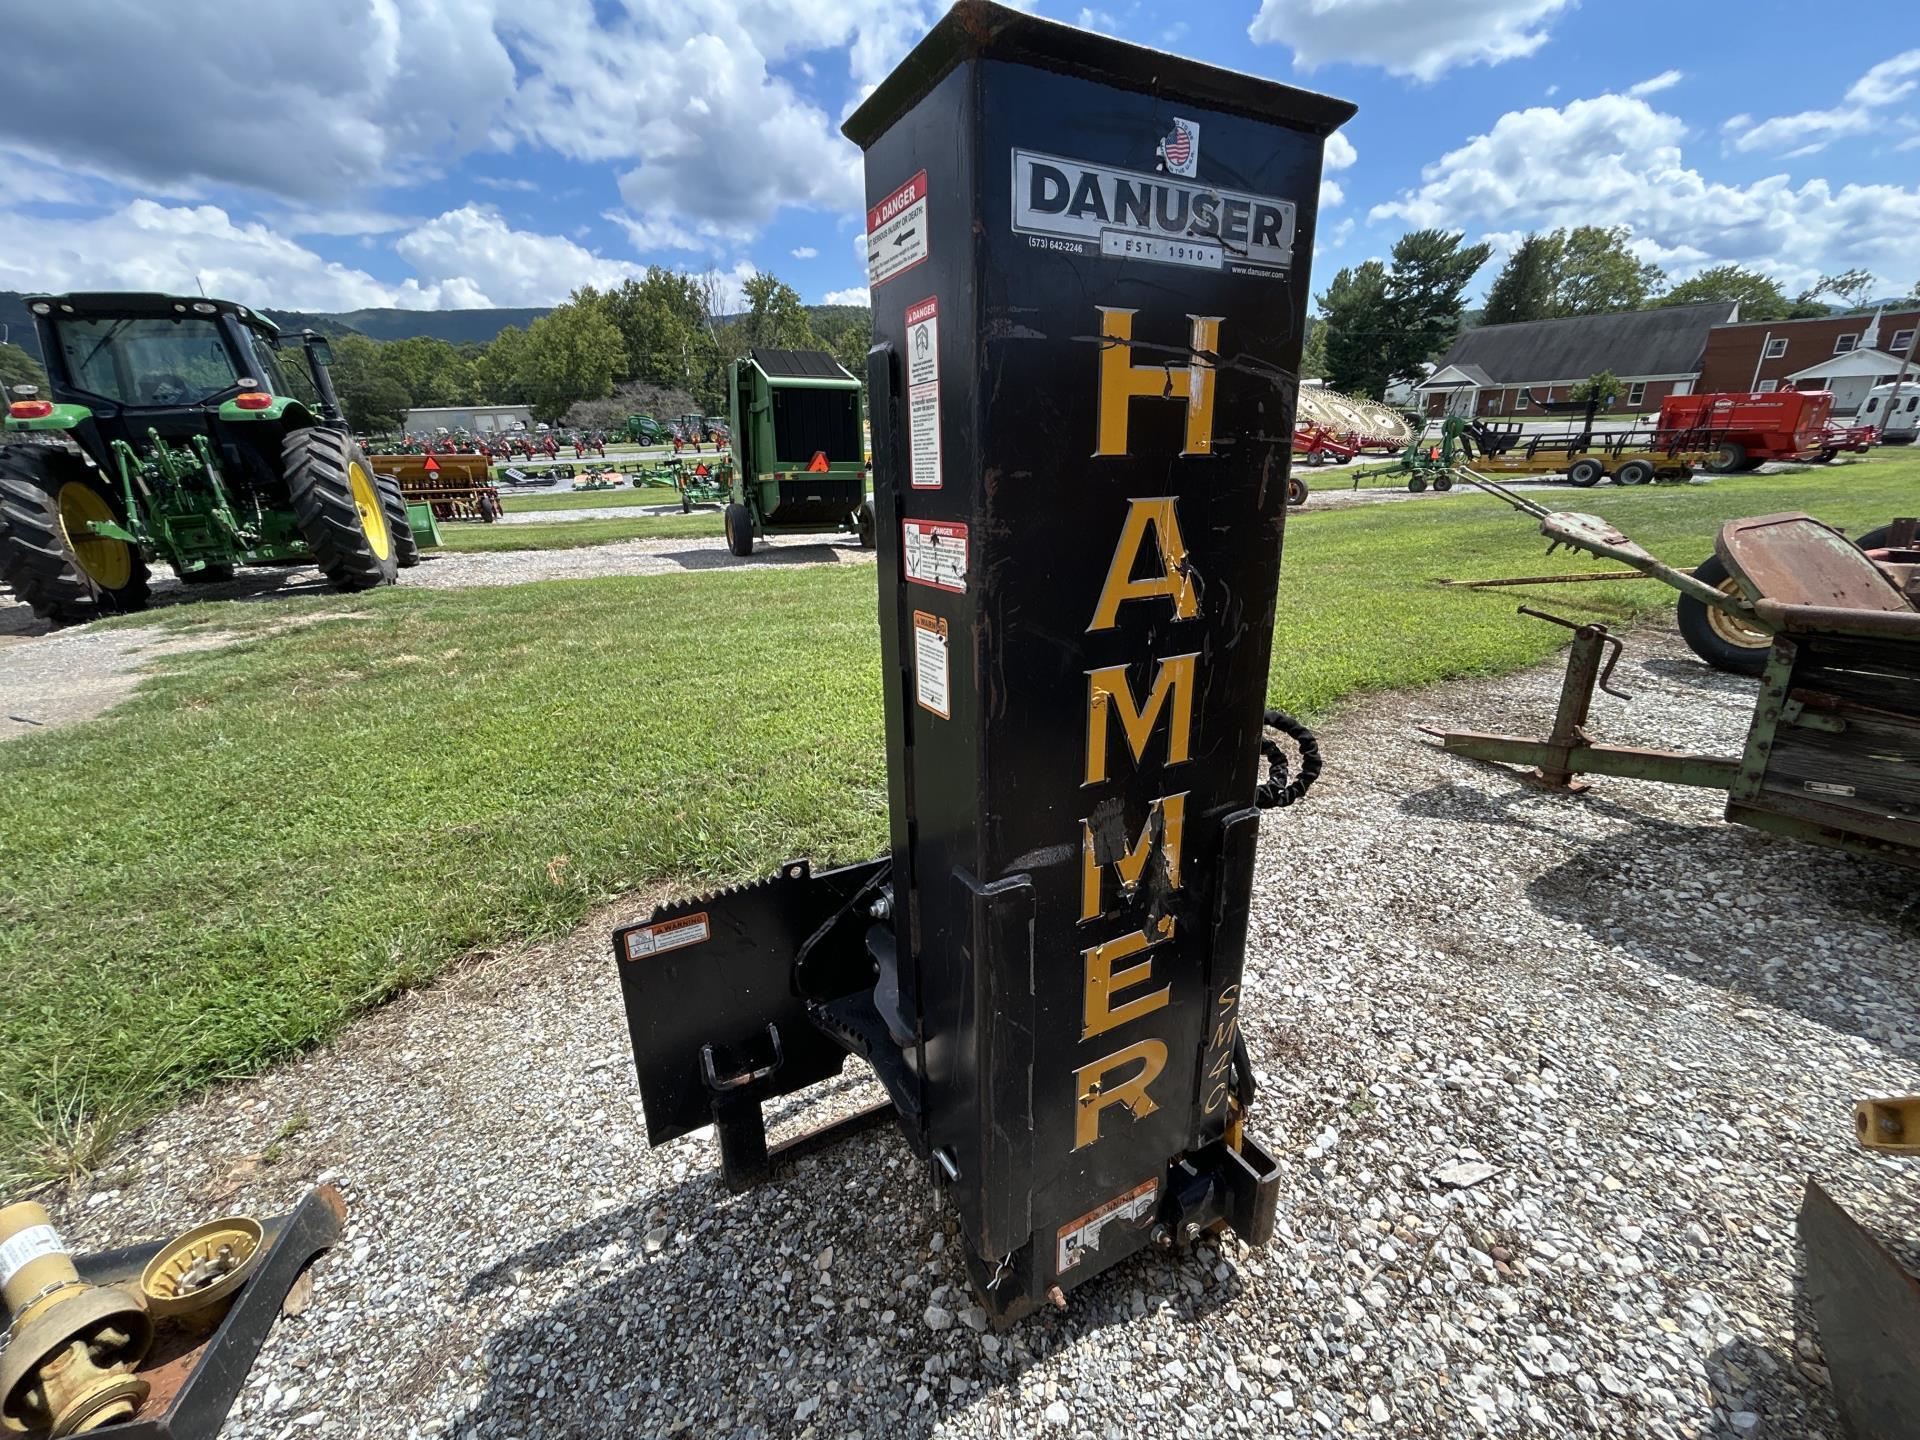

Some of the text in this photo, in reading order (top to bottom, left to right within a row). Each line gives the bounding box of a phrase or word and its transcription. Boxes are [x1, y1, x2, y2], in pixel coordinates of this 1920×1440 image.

[882, 184, 916, 221] DANGER
[887, 220, 902, 237] INJURY
[1028, 235, 1083, 253] (573) 642-2246
[1125, 239, 1203, 261] EST. 1910
[1231, 265, 1284, 279] www.danuser.com
[912, 303, 936, 321] DANGER
[920, 618, 945, 632] WARNNG
[1070, 305, 1226, 1153] HAMMER
[664, 915, 704, 932] WARNING
